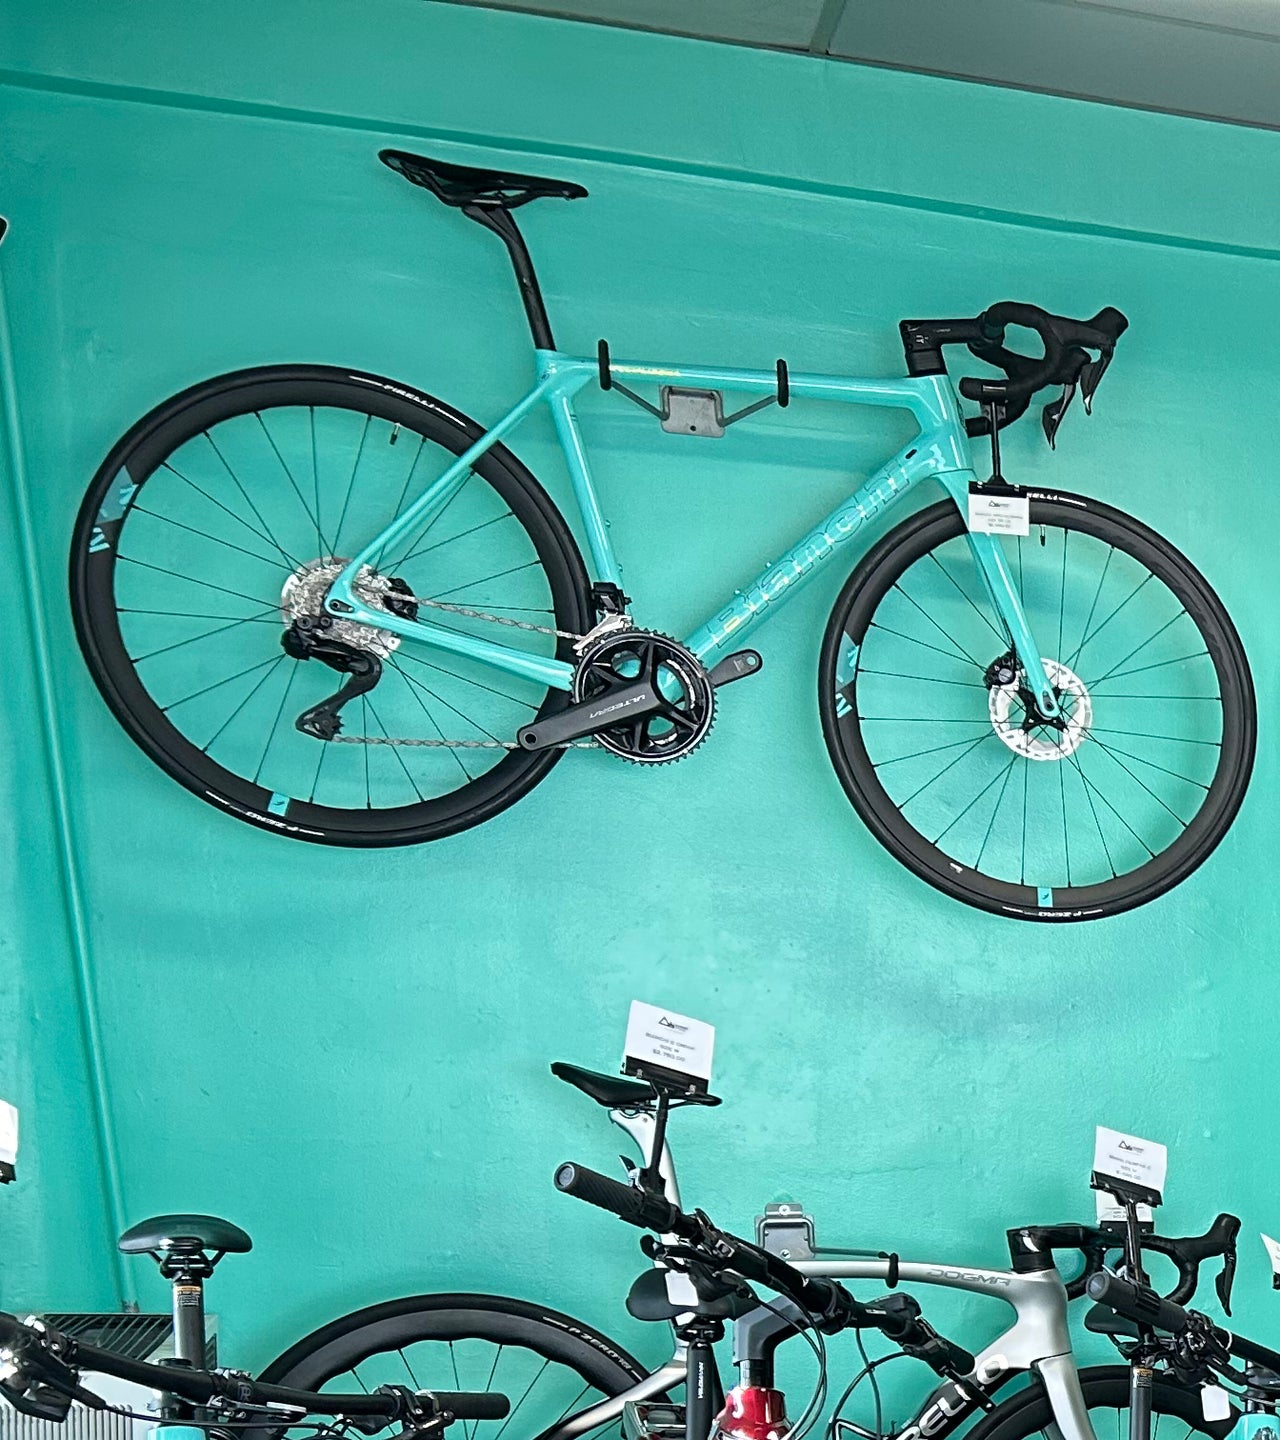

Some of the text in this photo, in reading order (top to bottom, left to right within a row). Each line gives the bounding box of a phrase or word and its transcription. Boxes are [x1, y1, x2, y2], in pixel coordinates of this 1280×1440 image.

[709, 455, 914, 648] Bianchi
[589, 694, 646, 720] ULTEGRA
[926, 1268, 1010, 1287] DOGMA
